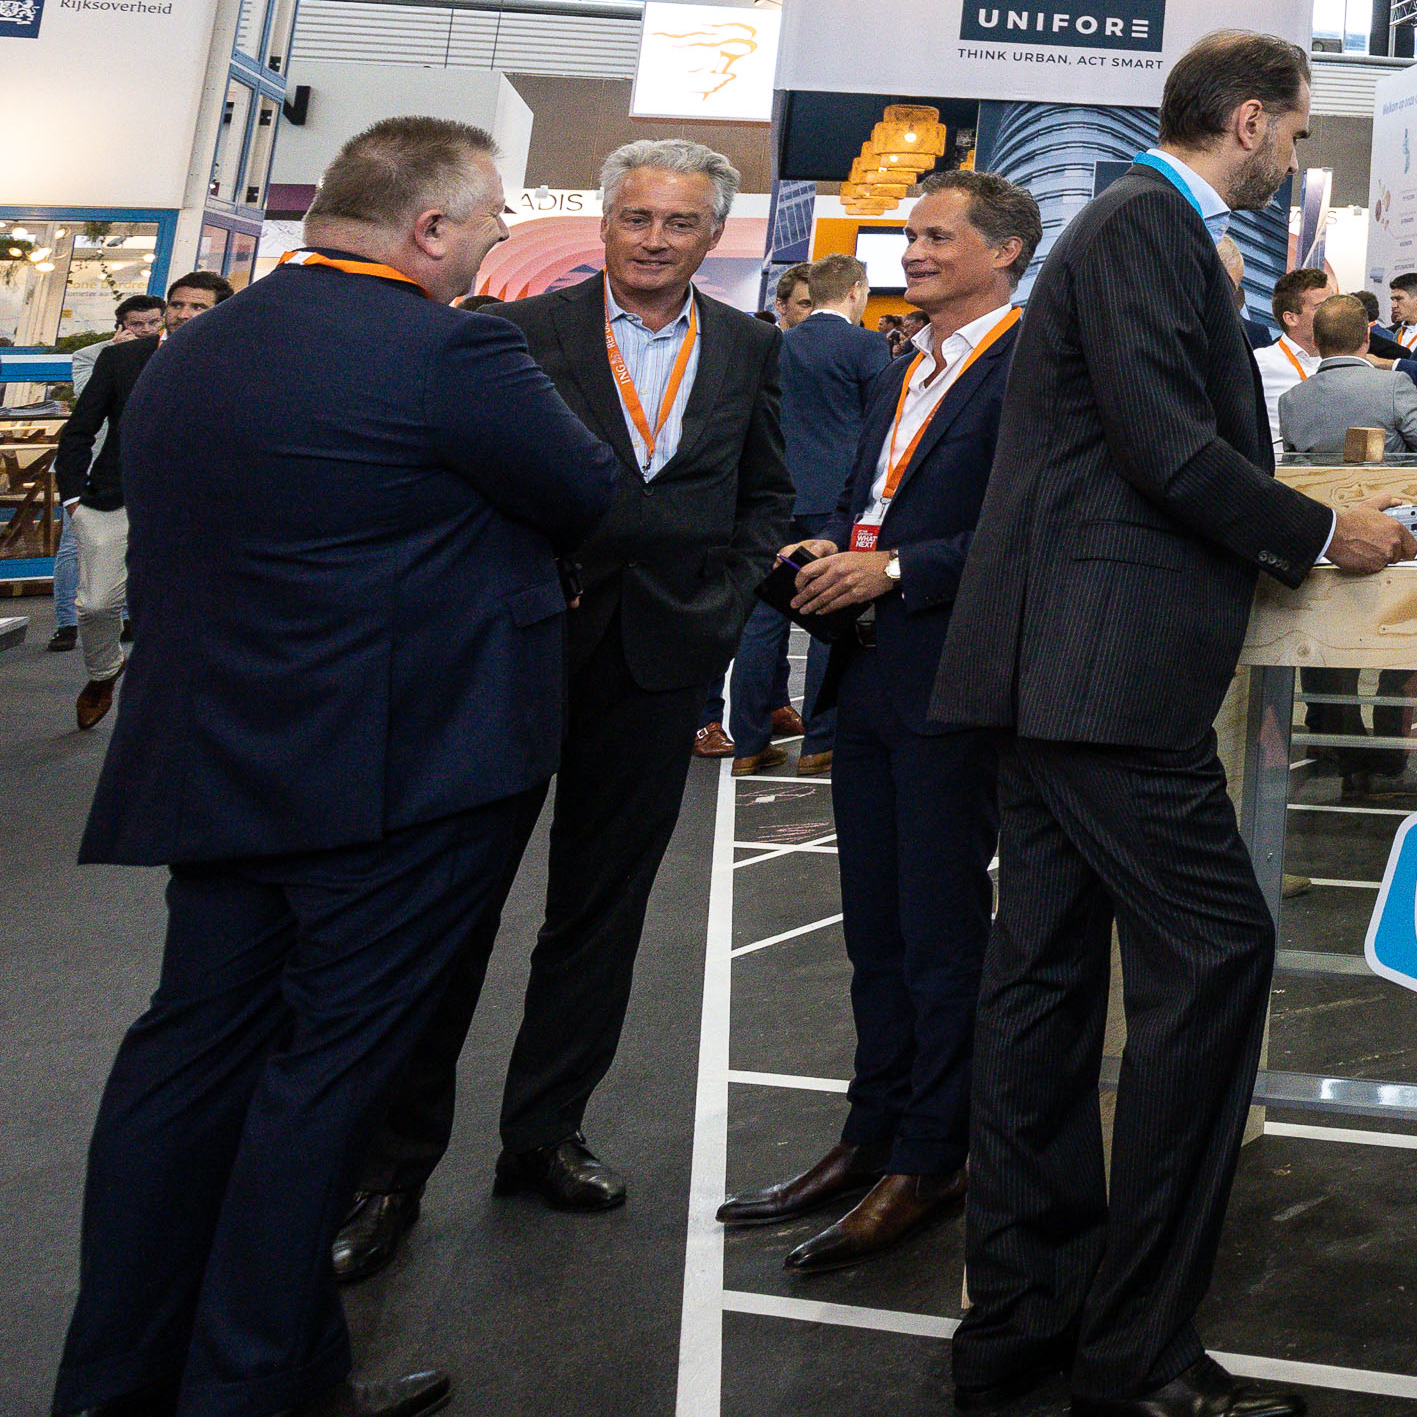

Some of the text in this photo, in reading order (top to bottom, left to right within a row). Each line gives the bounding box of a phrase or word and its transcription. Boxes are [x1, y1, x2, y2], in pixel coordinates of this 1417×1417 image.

[978, 8, 1149, 38] UNIFORE
[958, 48, 1164, 69] THINK URBAN, ACT SMART
[521, 193, 583, 211] ADIS
[615, 364, 632, 385] ING
